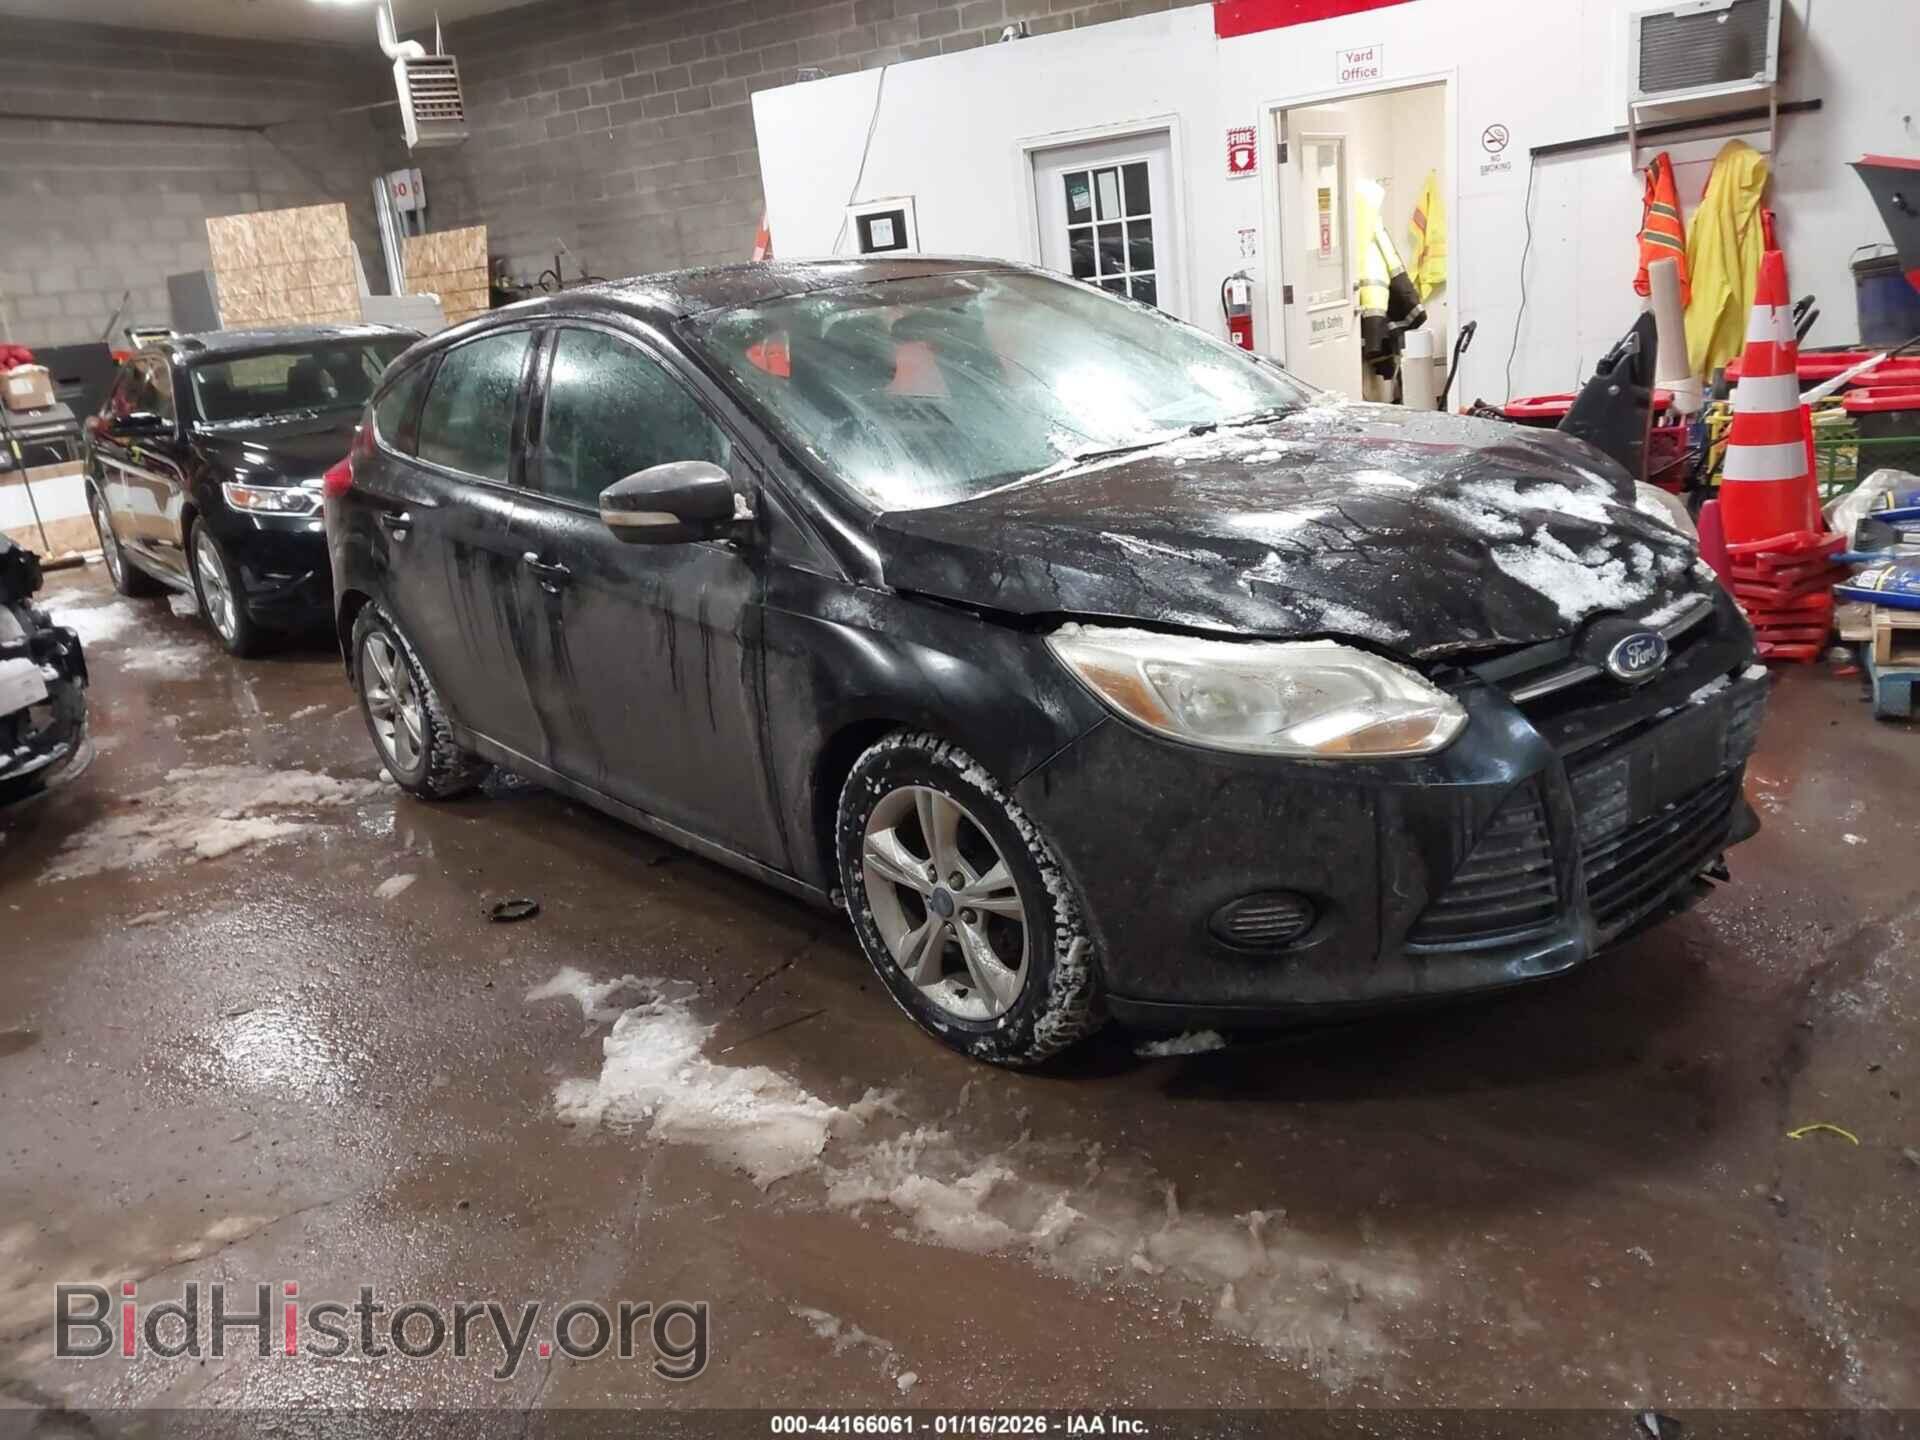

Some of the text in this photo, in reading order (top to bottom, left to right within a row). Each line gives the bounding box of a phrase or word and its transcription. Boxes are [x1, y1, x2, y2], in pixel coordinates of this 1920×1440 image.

[1346, 48, 1373, 64] Yard
[1342, 67, 1377, 80] Office
[1230, 132, 1252, 145] FIRE
[1490, 154, 1501, 162] NO
[1480, 161, 1511, 173] SMOKING
[1626, 639, 1657, 669] Ford
